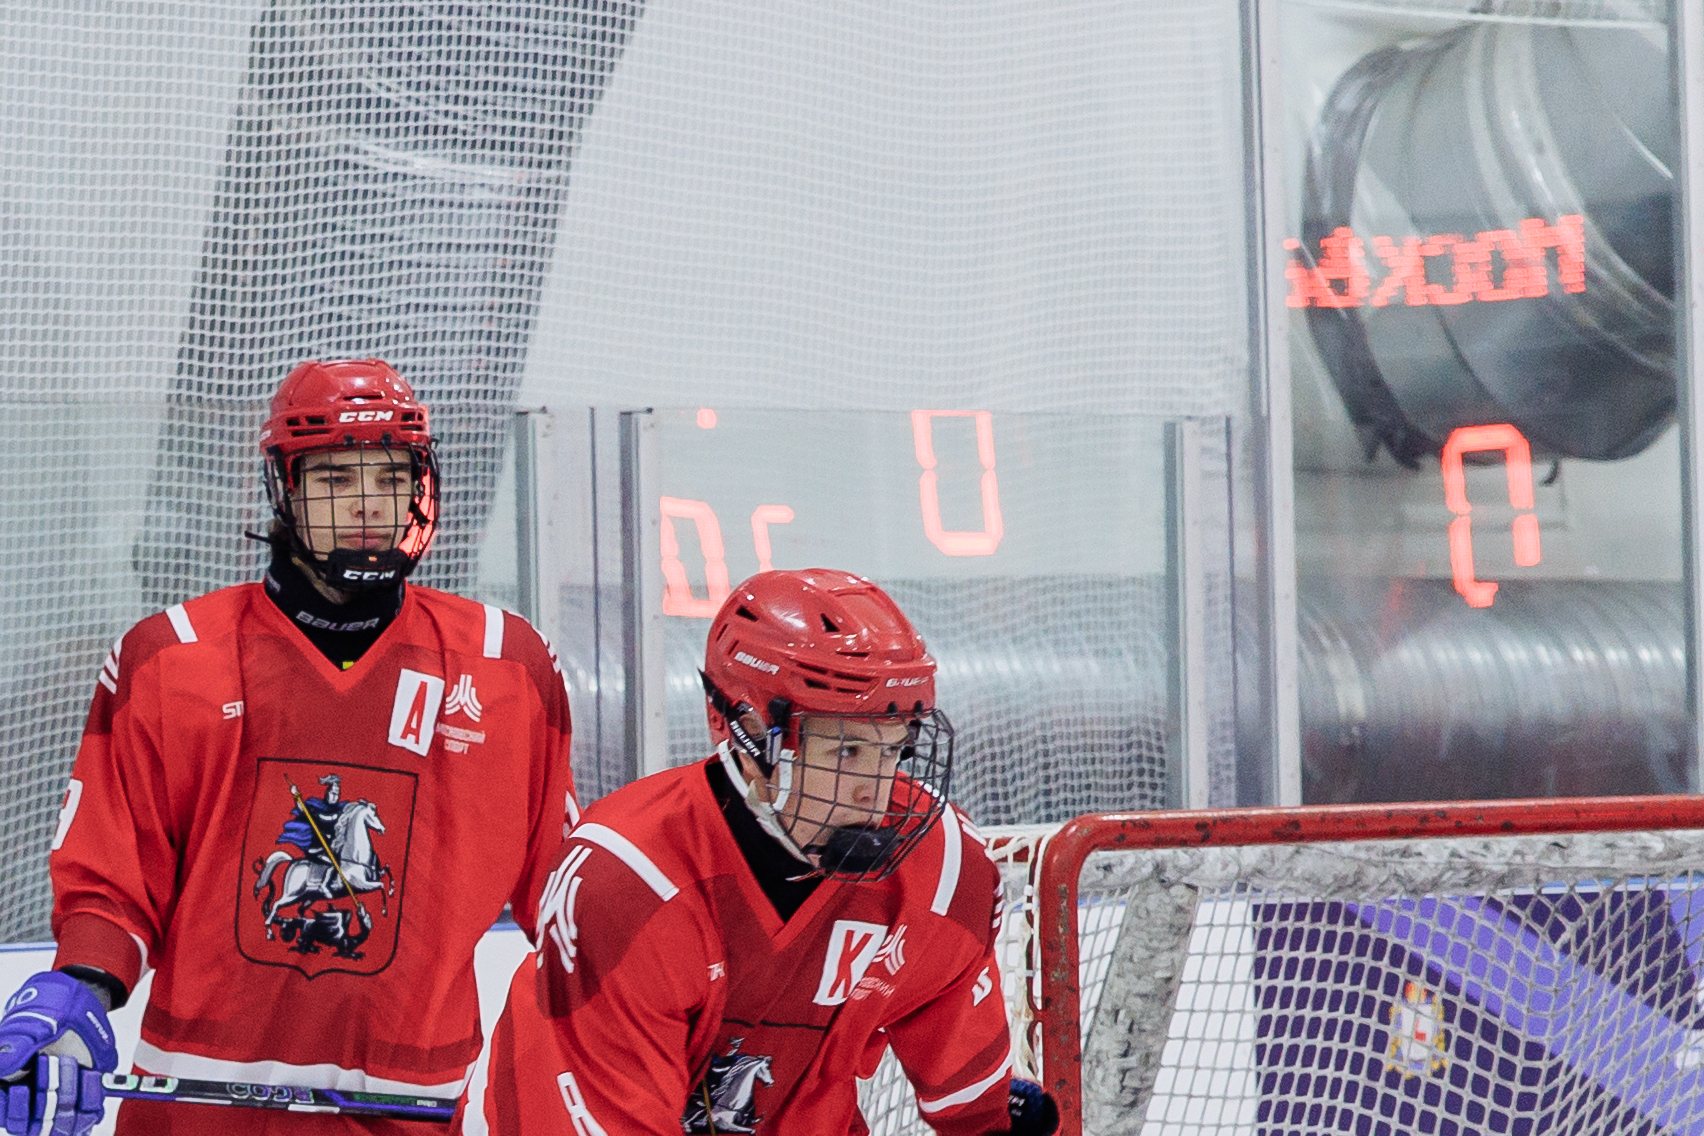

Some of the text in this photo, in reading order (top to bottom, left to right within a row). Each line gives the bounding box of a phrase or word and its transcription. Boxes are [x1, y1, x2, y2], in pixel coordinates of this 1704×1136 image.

[339, 411, 394, 423] CCM
[343, 569, 396, 580] CCM
[296, 610, 380, 632] BAUER
